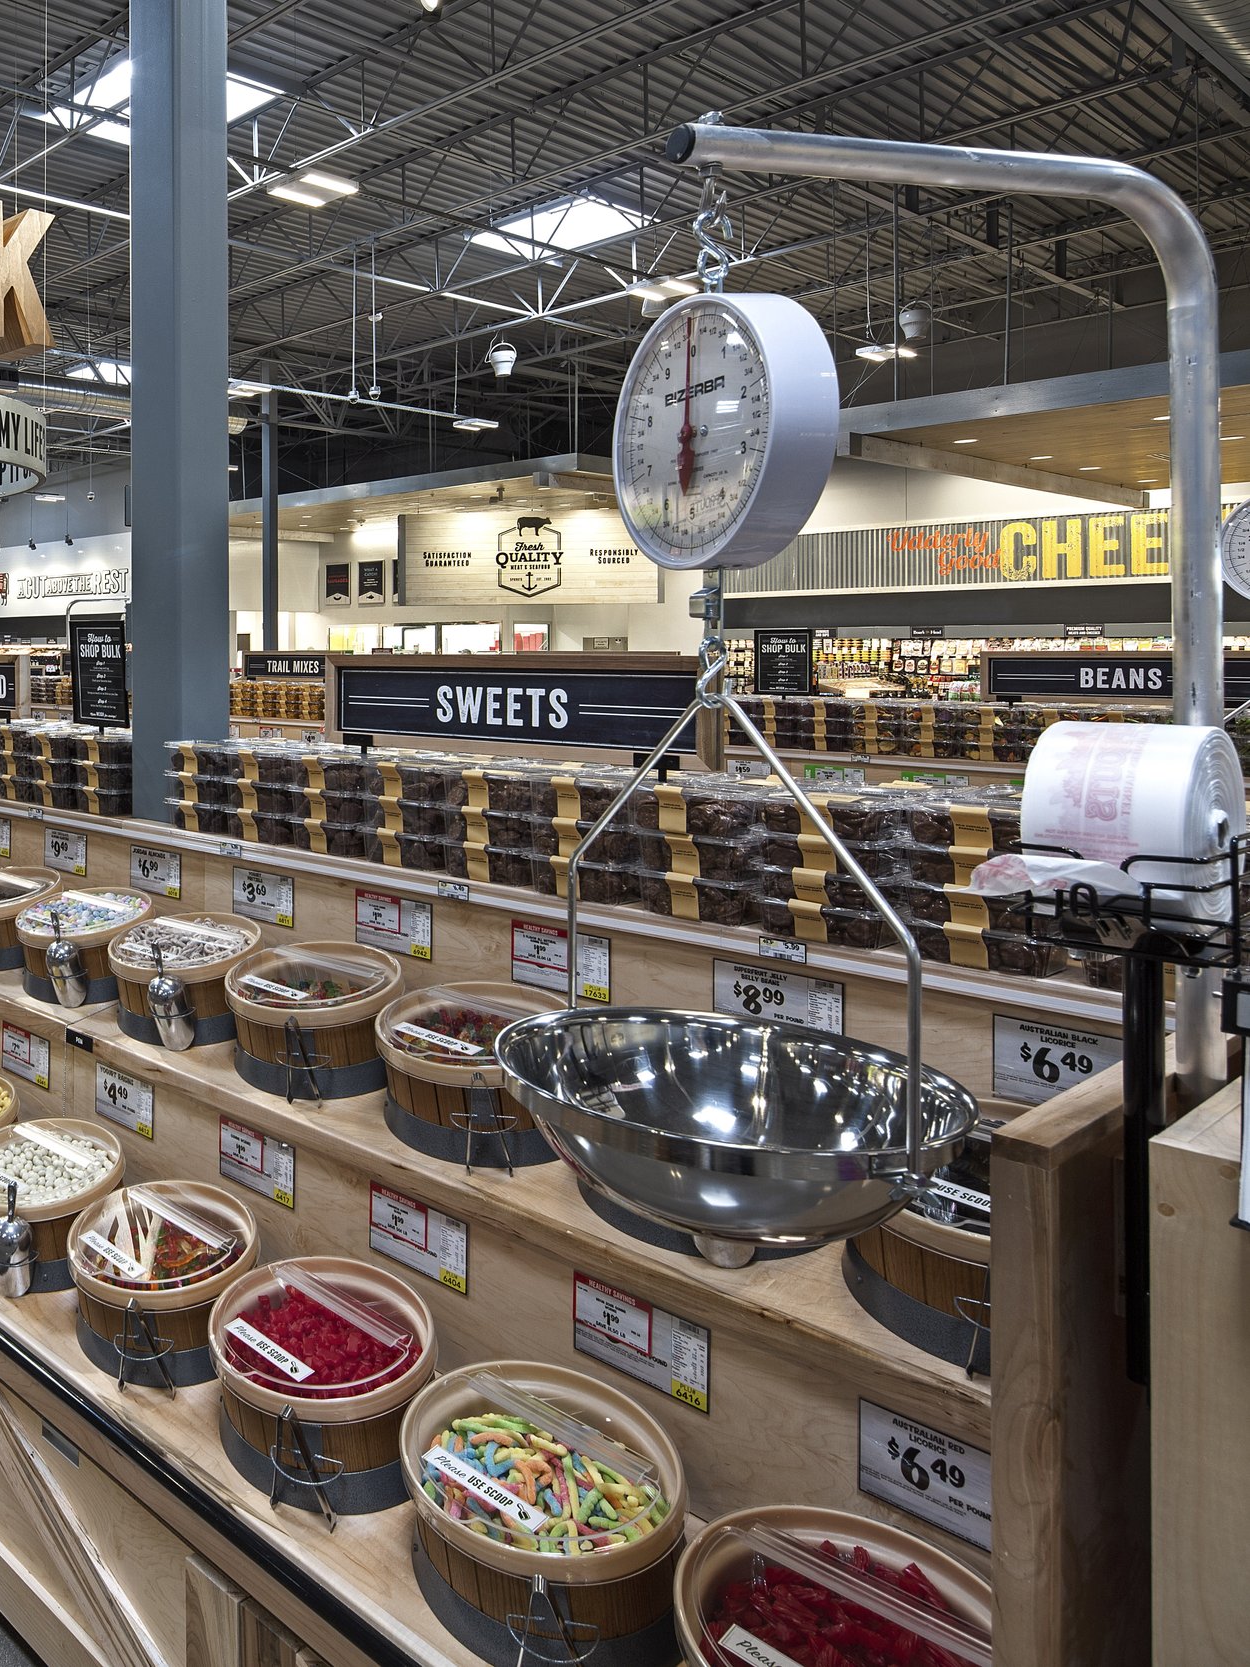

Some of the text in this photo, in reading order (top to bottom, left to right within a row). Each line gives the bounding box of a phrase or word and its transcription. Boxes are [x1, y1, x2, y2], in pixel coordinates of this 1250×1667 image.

[691, 345, 696, 357] 0
[722, 346, 726, 359] 1
[665, 368, 670, 380] 9
[665, 376, 725, 407] BIZERBA
[741, 386, 747, 399] 2
[647, 416, 653, 428] 8
[24, 416, 46, 462] LIFE
[740, 441, 746, 454] 3
[647, 465, 652, 476] 7
[664, 500, 669, 510] 6
[690, 508, 695, 520] 5
[515, 542, 544, 551] Fresh
[887, 527, 989, 554] Udderly
[590, 548, 638, 556] RESPONSIBLY
[496, 552, 564, 569] QUALITY
[938, 547, 1001, 576] Good
[25, 576, 47, 599] CUT
[47, 577, 73, 594] ABOVE
[74, 577, 91, 592] THE
[91, 568, 129, 594] REST
[88, 633, 112, 644] How to
[80, 644, 121, 658] SHOP BULK
[762, 644, 806, 653] SHOP BULK
[267, 660, 319, 673] TRAIL MIXES
[1080, 667, 1163, 690] BEANS
[436, 685, 569, 729] SWEETS
[523, 924, 558, 936] HEALTHY SAVINGS
[413, 949, 427, 957] 6942
[734, 965, 787, 982] SUPERFRUIT JELLY
[741, 974, 780, 987] BELLY BEANS
[584, 989, 606, 1000] 17633
[786, 1015, 804, 1024] POUND
[437, 1035, 458, 1046] SCOOP
[1019, 1024, 1098, 1046] AUSTRALIAN BLACK
[1040, 1036, 1076, 1049] LICORICE
[99, 1065, 116, 1079] YOGURT
[276, 1193, 289, 1204] 6417
[938, 1184, 990, 1207] USE SCOO
[443, 1276, 460, 1288] 6404
[588, 1279, 636, 1306] HEALTHY SAVINGS
[256, 1340, 270, 1351] USE
[267, 1348, 289, 1364] SCOOP
[680, 1382, 696, 1394] PLU#
[676, 1388, 700, 1406] 6416
[892, 1418, 965, 1455] AUSTRALIAN RED
[909, 1434, 947, 1456] LICORICE
[467, 1475, 485, 1490] USE
[484, 1486, 514, 1506] SCOOP
[949, 1496, 963, 1508] PER
